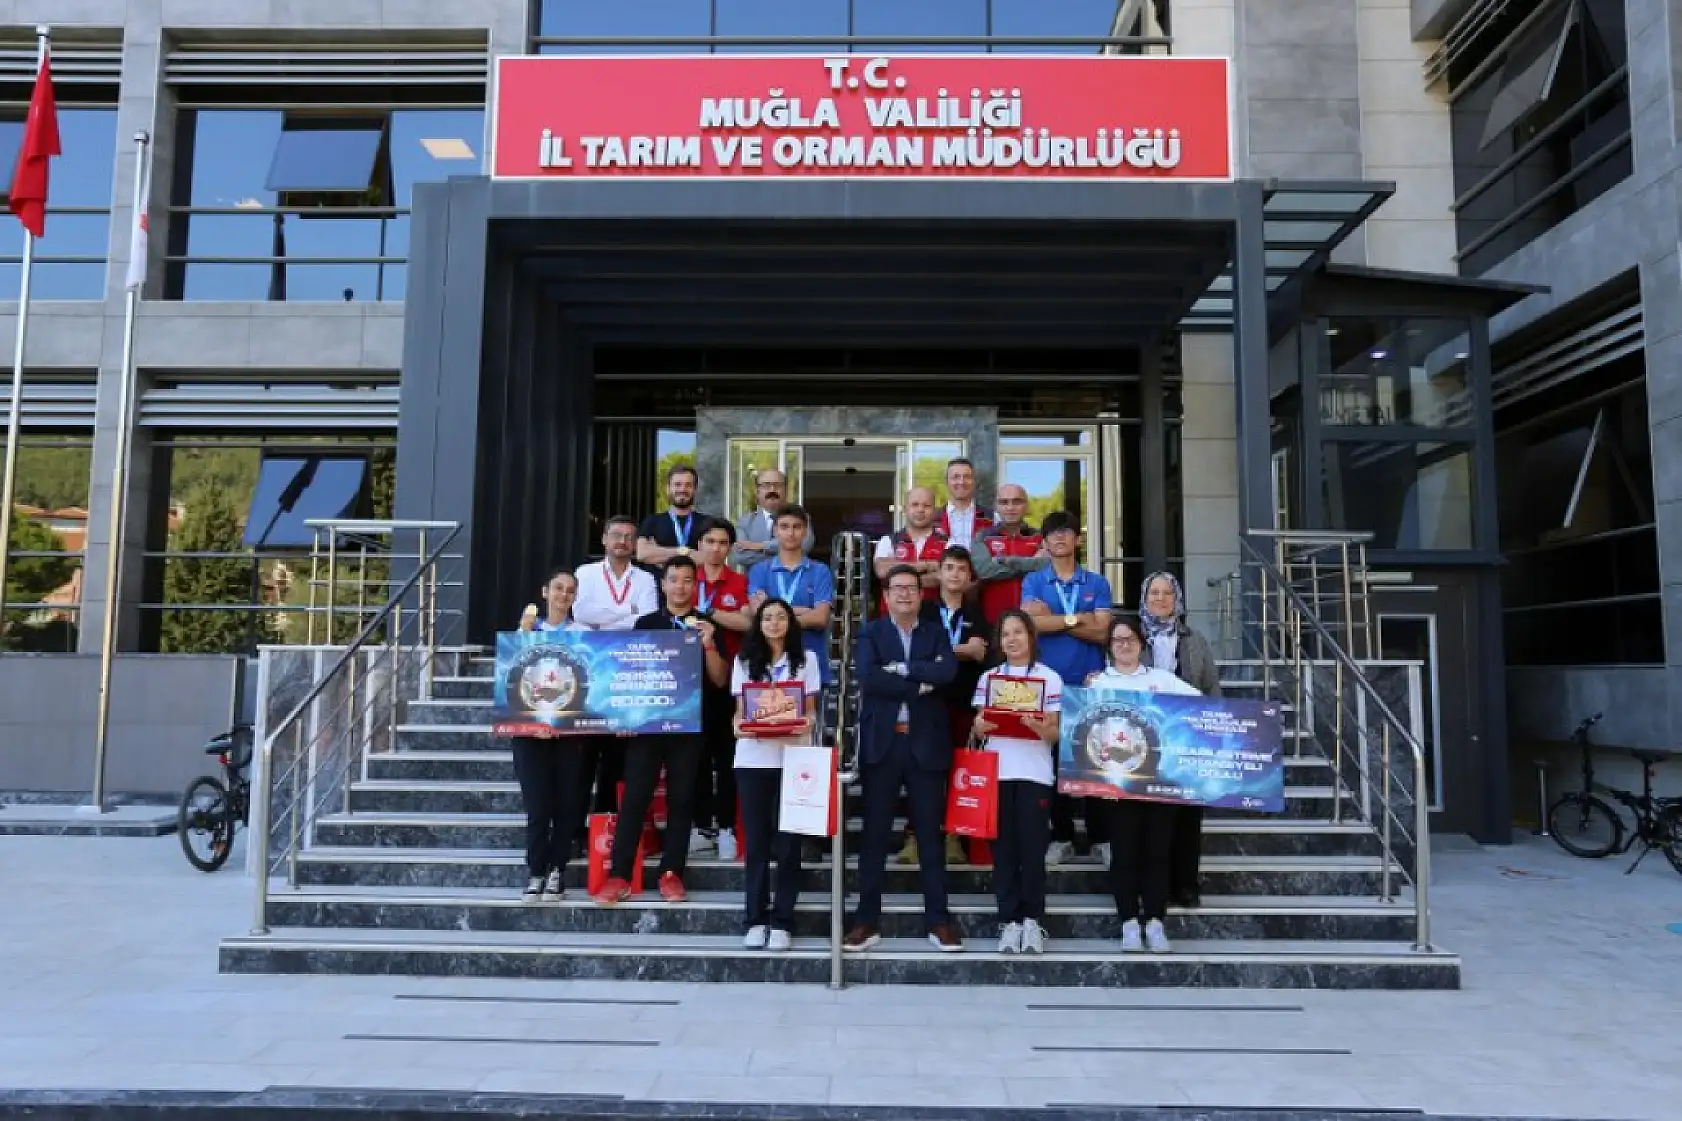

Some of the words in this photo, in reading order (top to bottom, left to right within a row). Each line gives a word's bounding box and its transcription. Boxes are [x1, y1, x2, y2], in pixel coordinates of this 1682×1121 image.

[700, 88, 840, 128] MUĞLA
[864, 87, 1021, 127] VALİLİĞİ
[539, 128, 573, 168] İL
[580, 136, 700, 168] TARIM
[712, 136, 763, 168] VE
[772, 136, 925, 168] ORMAN
[931, 127, 1181, 168] MÜDÜRLÜĞÜ
